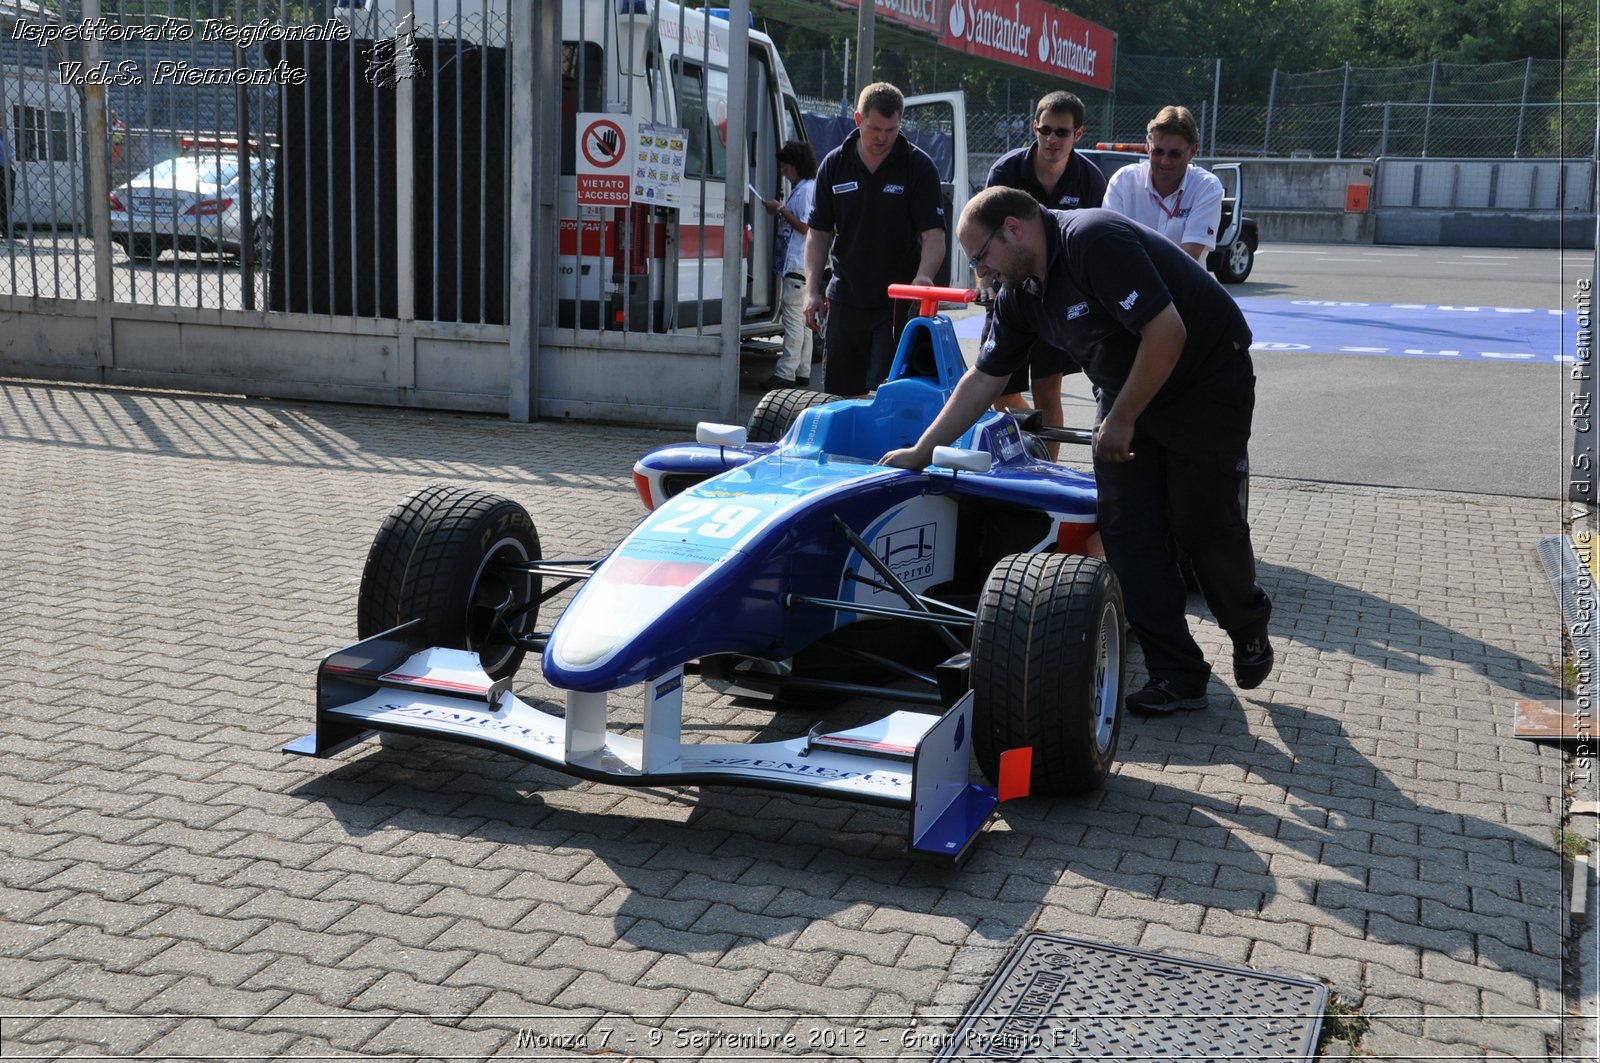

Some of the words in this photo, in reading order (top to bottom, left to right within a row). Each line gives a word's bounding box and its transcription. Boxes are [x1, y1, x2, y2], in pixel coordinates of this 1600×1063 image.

[1050, 20, 1098, 77] Santander
[577, 190, 629, 201] L'ACCESSO
[582, 179, 625, 189] VIETATO
[651, 501, 762, 539] 29
